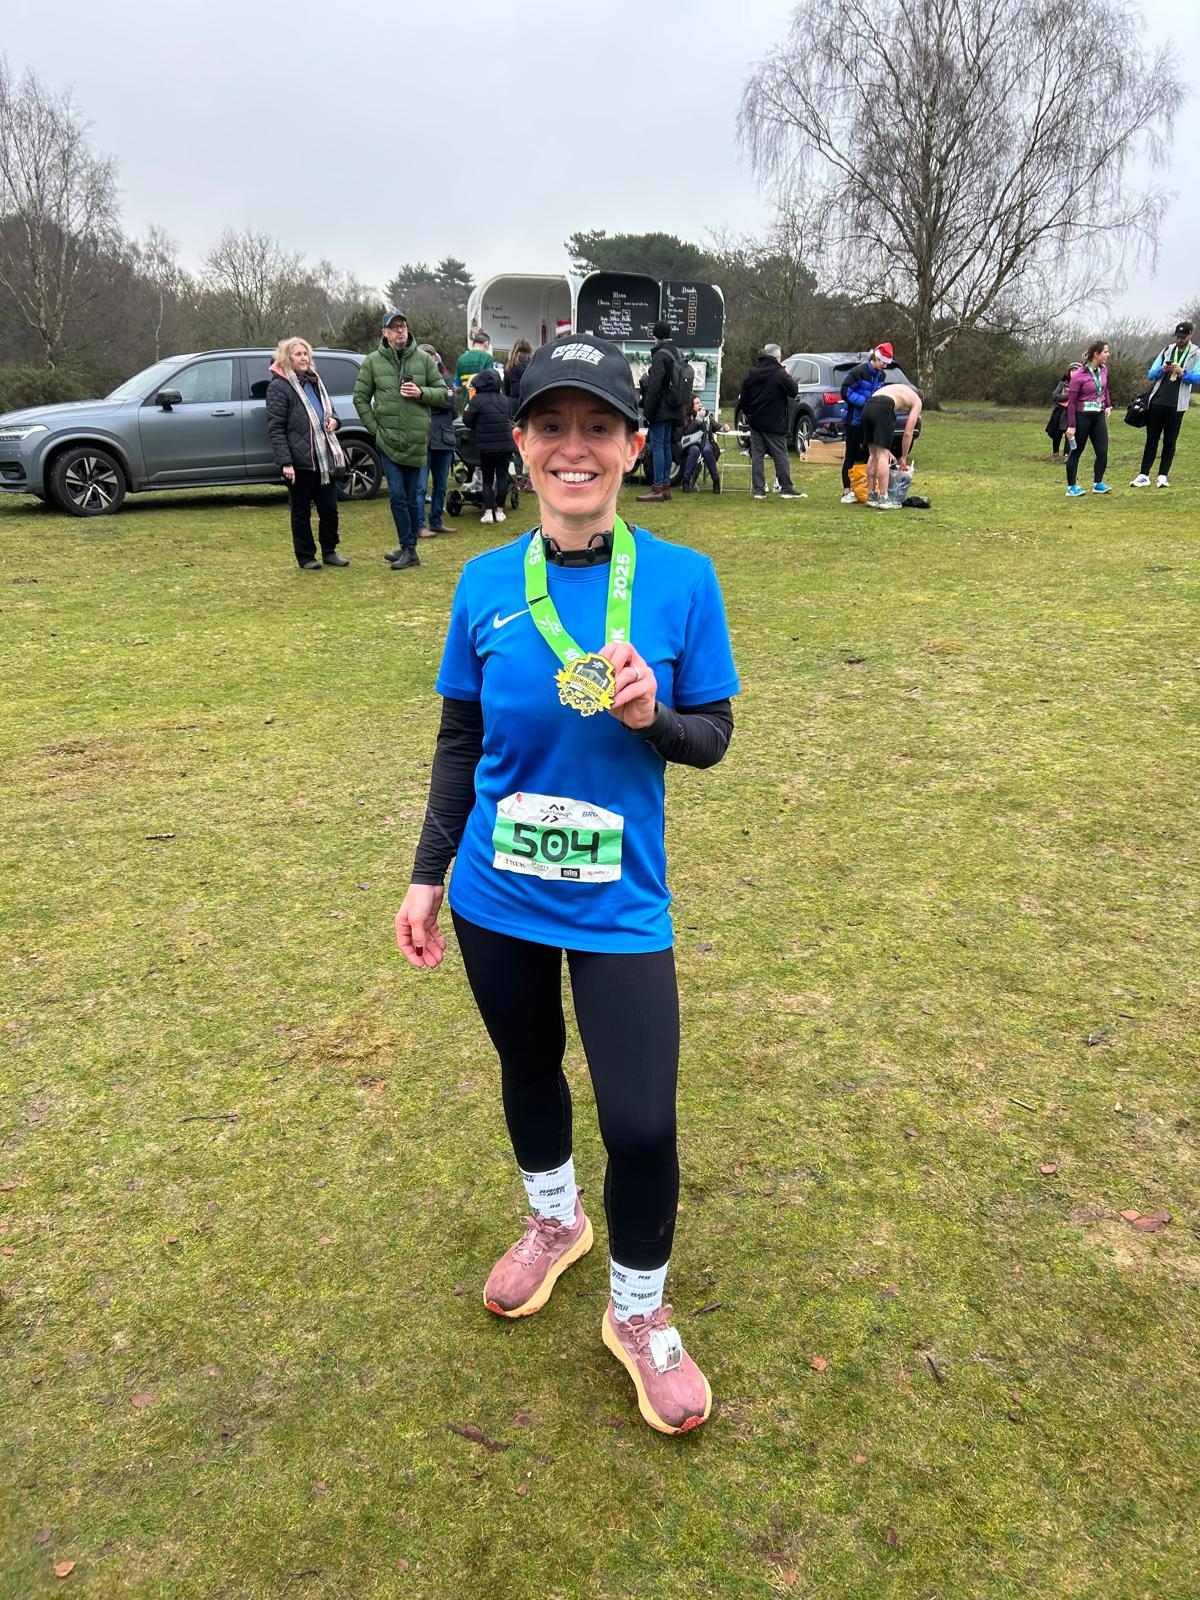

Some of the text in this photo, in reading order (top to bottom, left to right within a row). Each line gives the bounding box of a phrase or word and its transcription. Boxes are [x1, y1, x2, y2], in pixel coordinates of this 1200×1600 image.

[613, 553, 630, 601] 2025
[610, 627, 625, 643] K
[570, 675, 604, 697] BIRMINGHAM
[512, 822, 600, 863] 504
